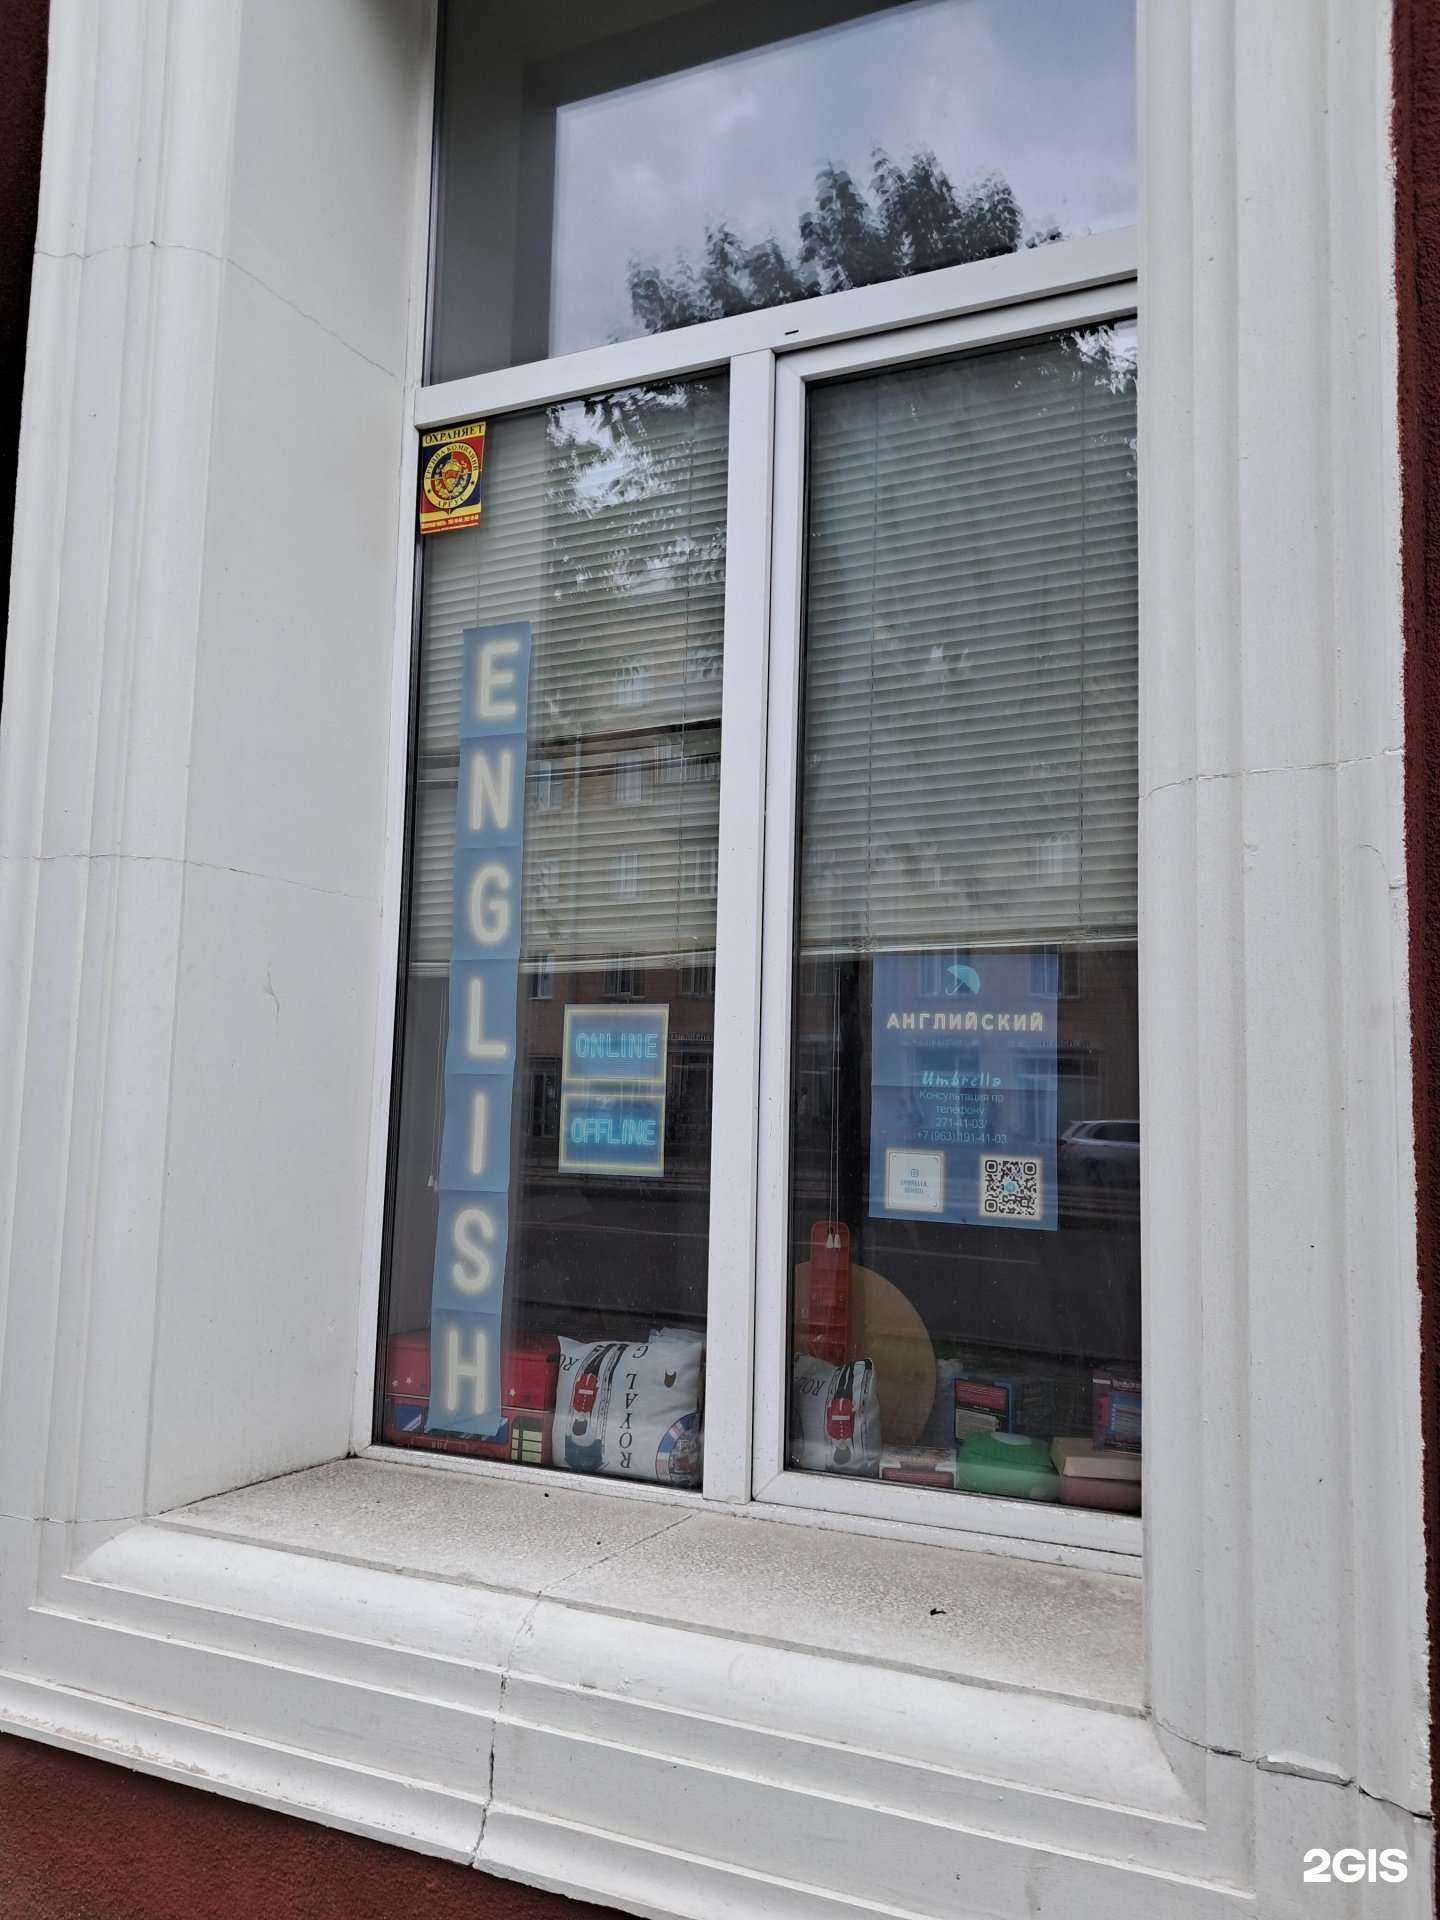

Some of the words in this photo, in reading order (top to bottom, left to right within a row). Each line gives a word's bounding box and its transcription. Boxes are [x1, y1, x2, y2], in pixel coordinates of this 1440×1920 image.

[425, 423, 484, 445] ОХРАНЯЕТ
[446, 638, 521, 1415] ENGLISH
[886, 1011, 1043, 1032] АНГЛИЙСКИЙ
[575, 1032, 658, 1059] ONLINE
[921, 1071, 1001, 1087] Umbrella
[571, 1117, 657, 1146] OFFLINE
